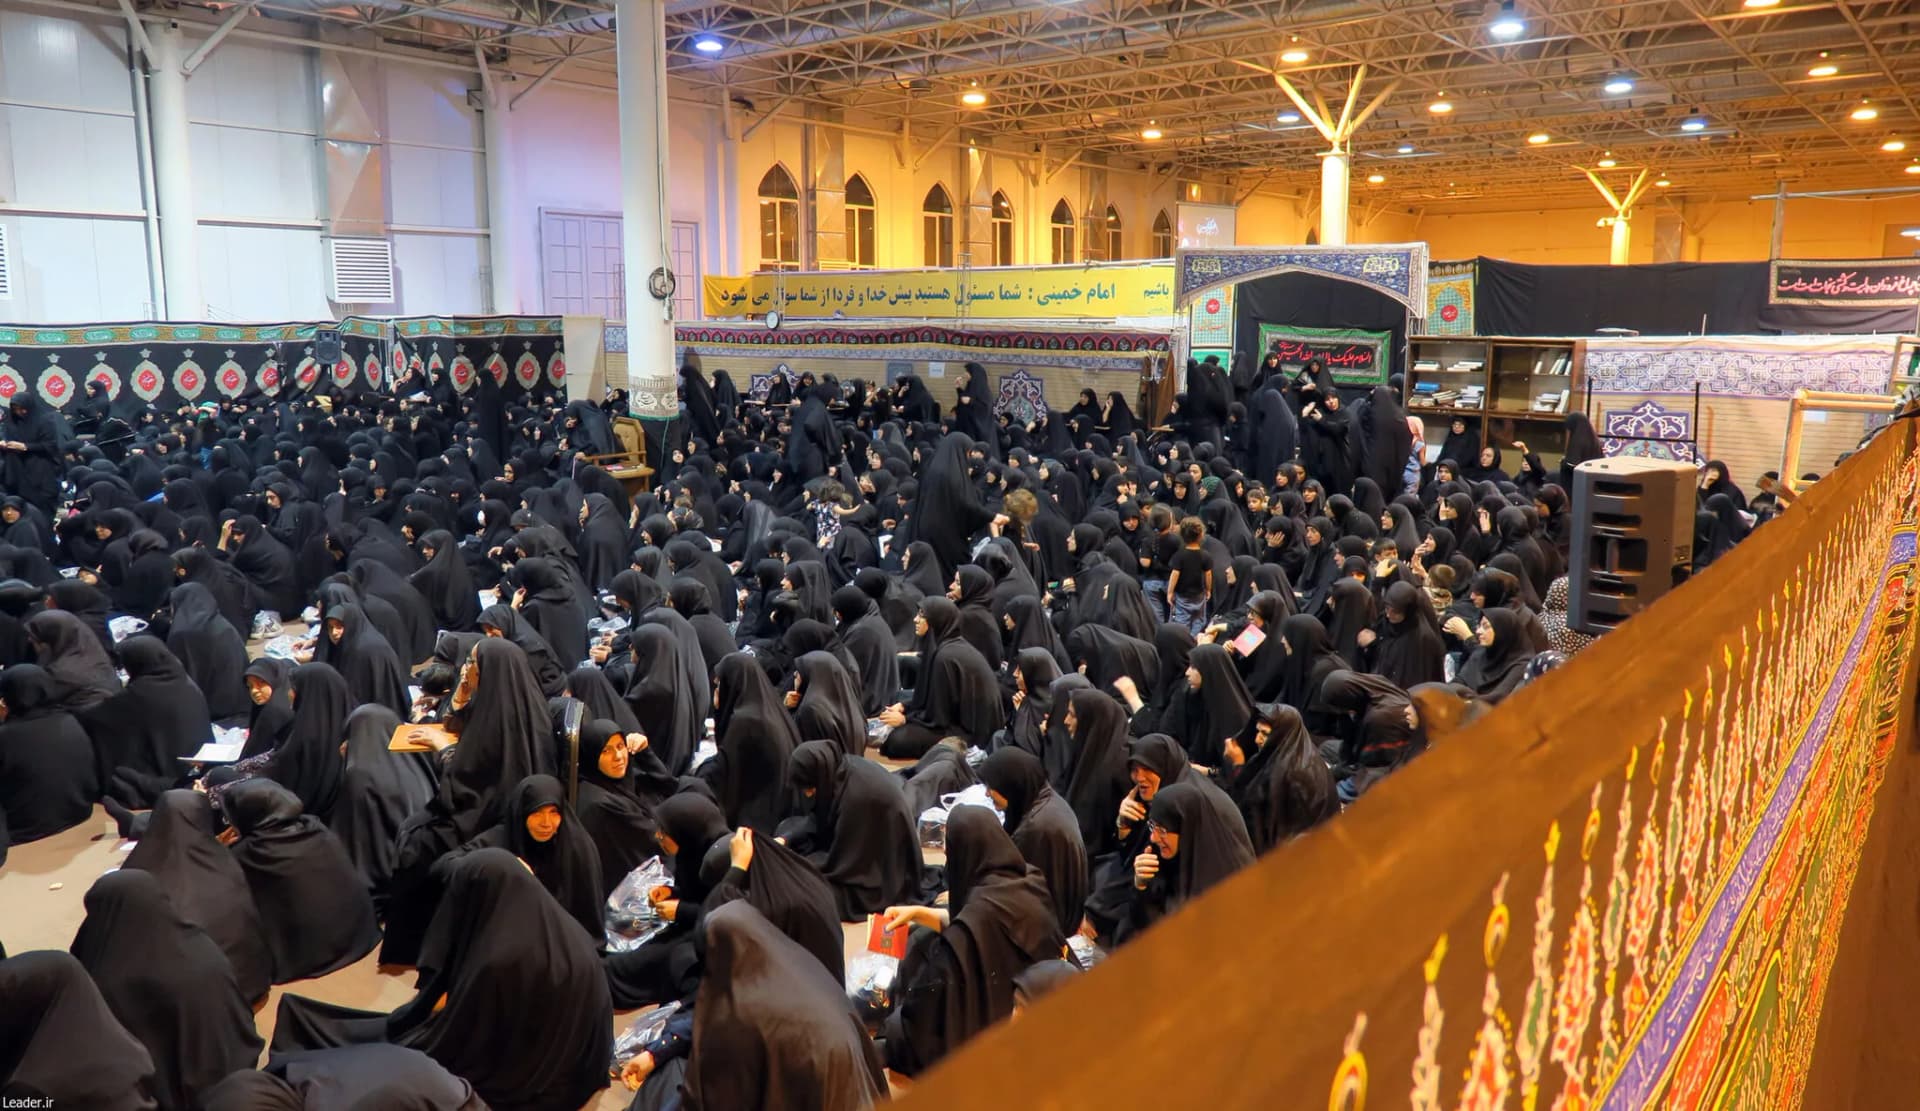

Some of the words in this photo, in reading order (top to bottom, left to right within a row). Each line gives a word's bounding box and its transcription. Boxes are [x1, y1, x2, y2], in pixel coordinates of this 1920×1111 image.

[720, 286, 748, 306] شود
[751, 292, 769, 306] می
[800, 286, 818, 301] شما
[820, 288, 830, 307] از
[833, 285, 854, 306] فردا
[858, 293, 864, 307] و
[866, 285, 887, 301] خدا
[888, 285, 912, 306] پیش
[914, 285, 951, 305] هستید
[954, 284, 995, 305] مسئول
[999, 284, 1022, 300] شما
[1037, 282, 1082, 306] خمینی
[1086, 283, 1116, 304] امام
[1143, 283, 1169, 299] باشیم
